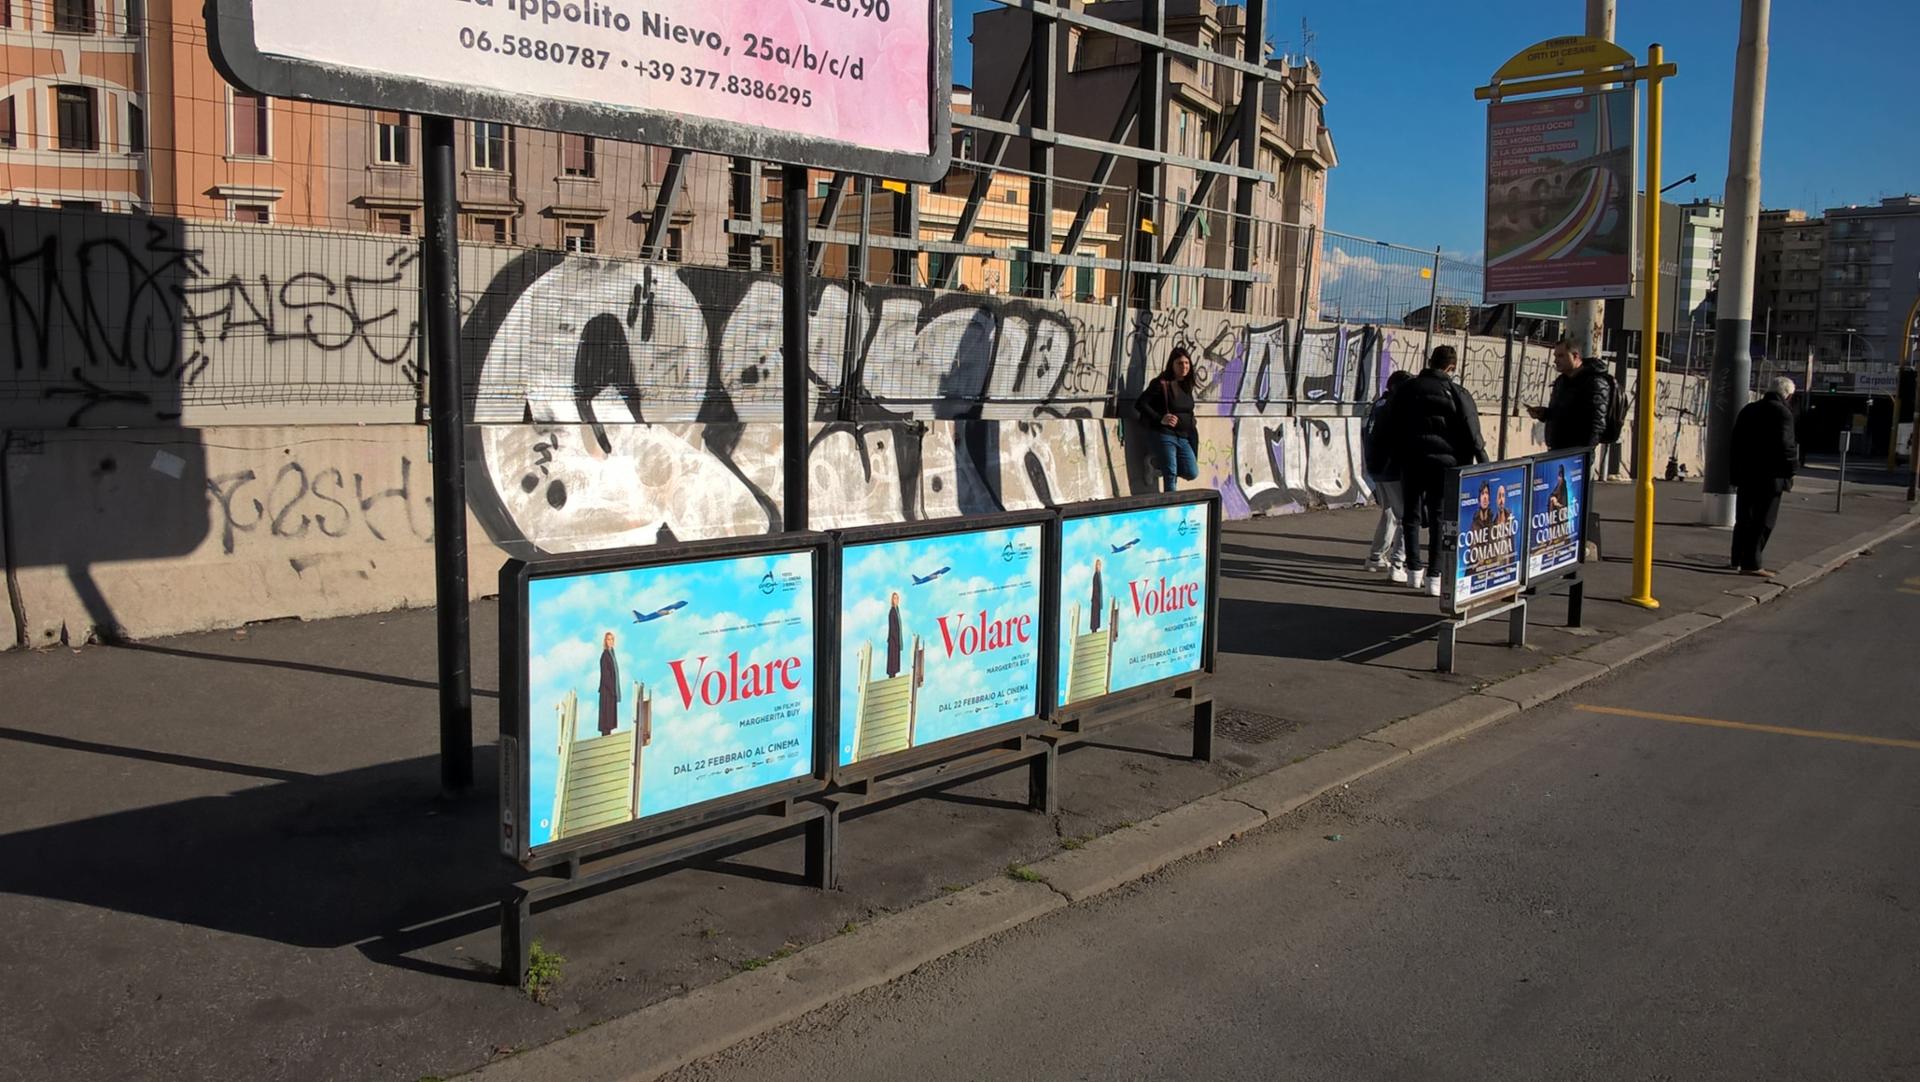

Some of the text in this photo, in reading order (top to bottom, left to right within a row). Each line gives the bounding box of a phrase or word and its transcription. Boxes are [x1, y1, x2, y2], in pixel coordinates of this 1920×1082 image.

[642, 11, 731, 56] Nievo,
[743, 33, 864, 80] 25a/b/c/d
[459, 27, 610, 70] 06.5880787
[681, 66, 812, 107] 377.8386295
[1458, 513, 1519, 548] COME CRISTO
[1532, 509, 1557, 528] COME
[1463, 538, 1513, 564] COMANDA
[1128, 576, 1198, 618] Volare
[936, 609, 1031, 659] Volare
[667, 651, 801, 711] Volare
[939, 704, 952, 713] DAL
[954, 700, 961, 709] 22
[963, 692, 996, 706] FEBBRAIO
[997, 690, 1005, 698] AL
[1007, 683, 1029, 696] CINEMA
[739, 708, 800, 728] MARGHERITA BUY
[673, 763, 692, 775] DAL
[695, 758, 706, 770] 22
[708, 749, 753, 767] FEBBRAIO
[755, 746, 765, 757] AL
[768, 738, 800, 753] CINEMA
